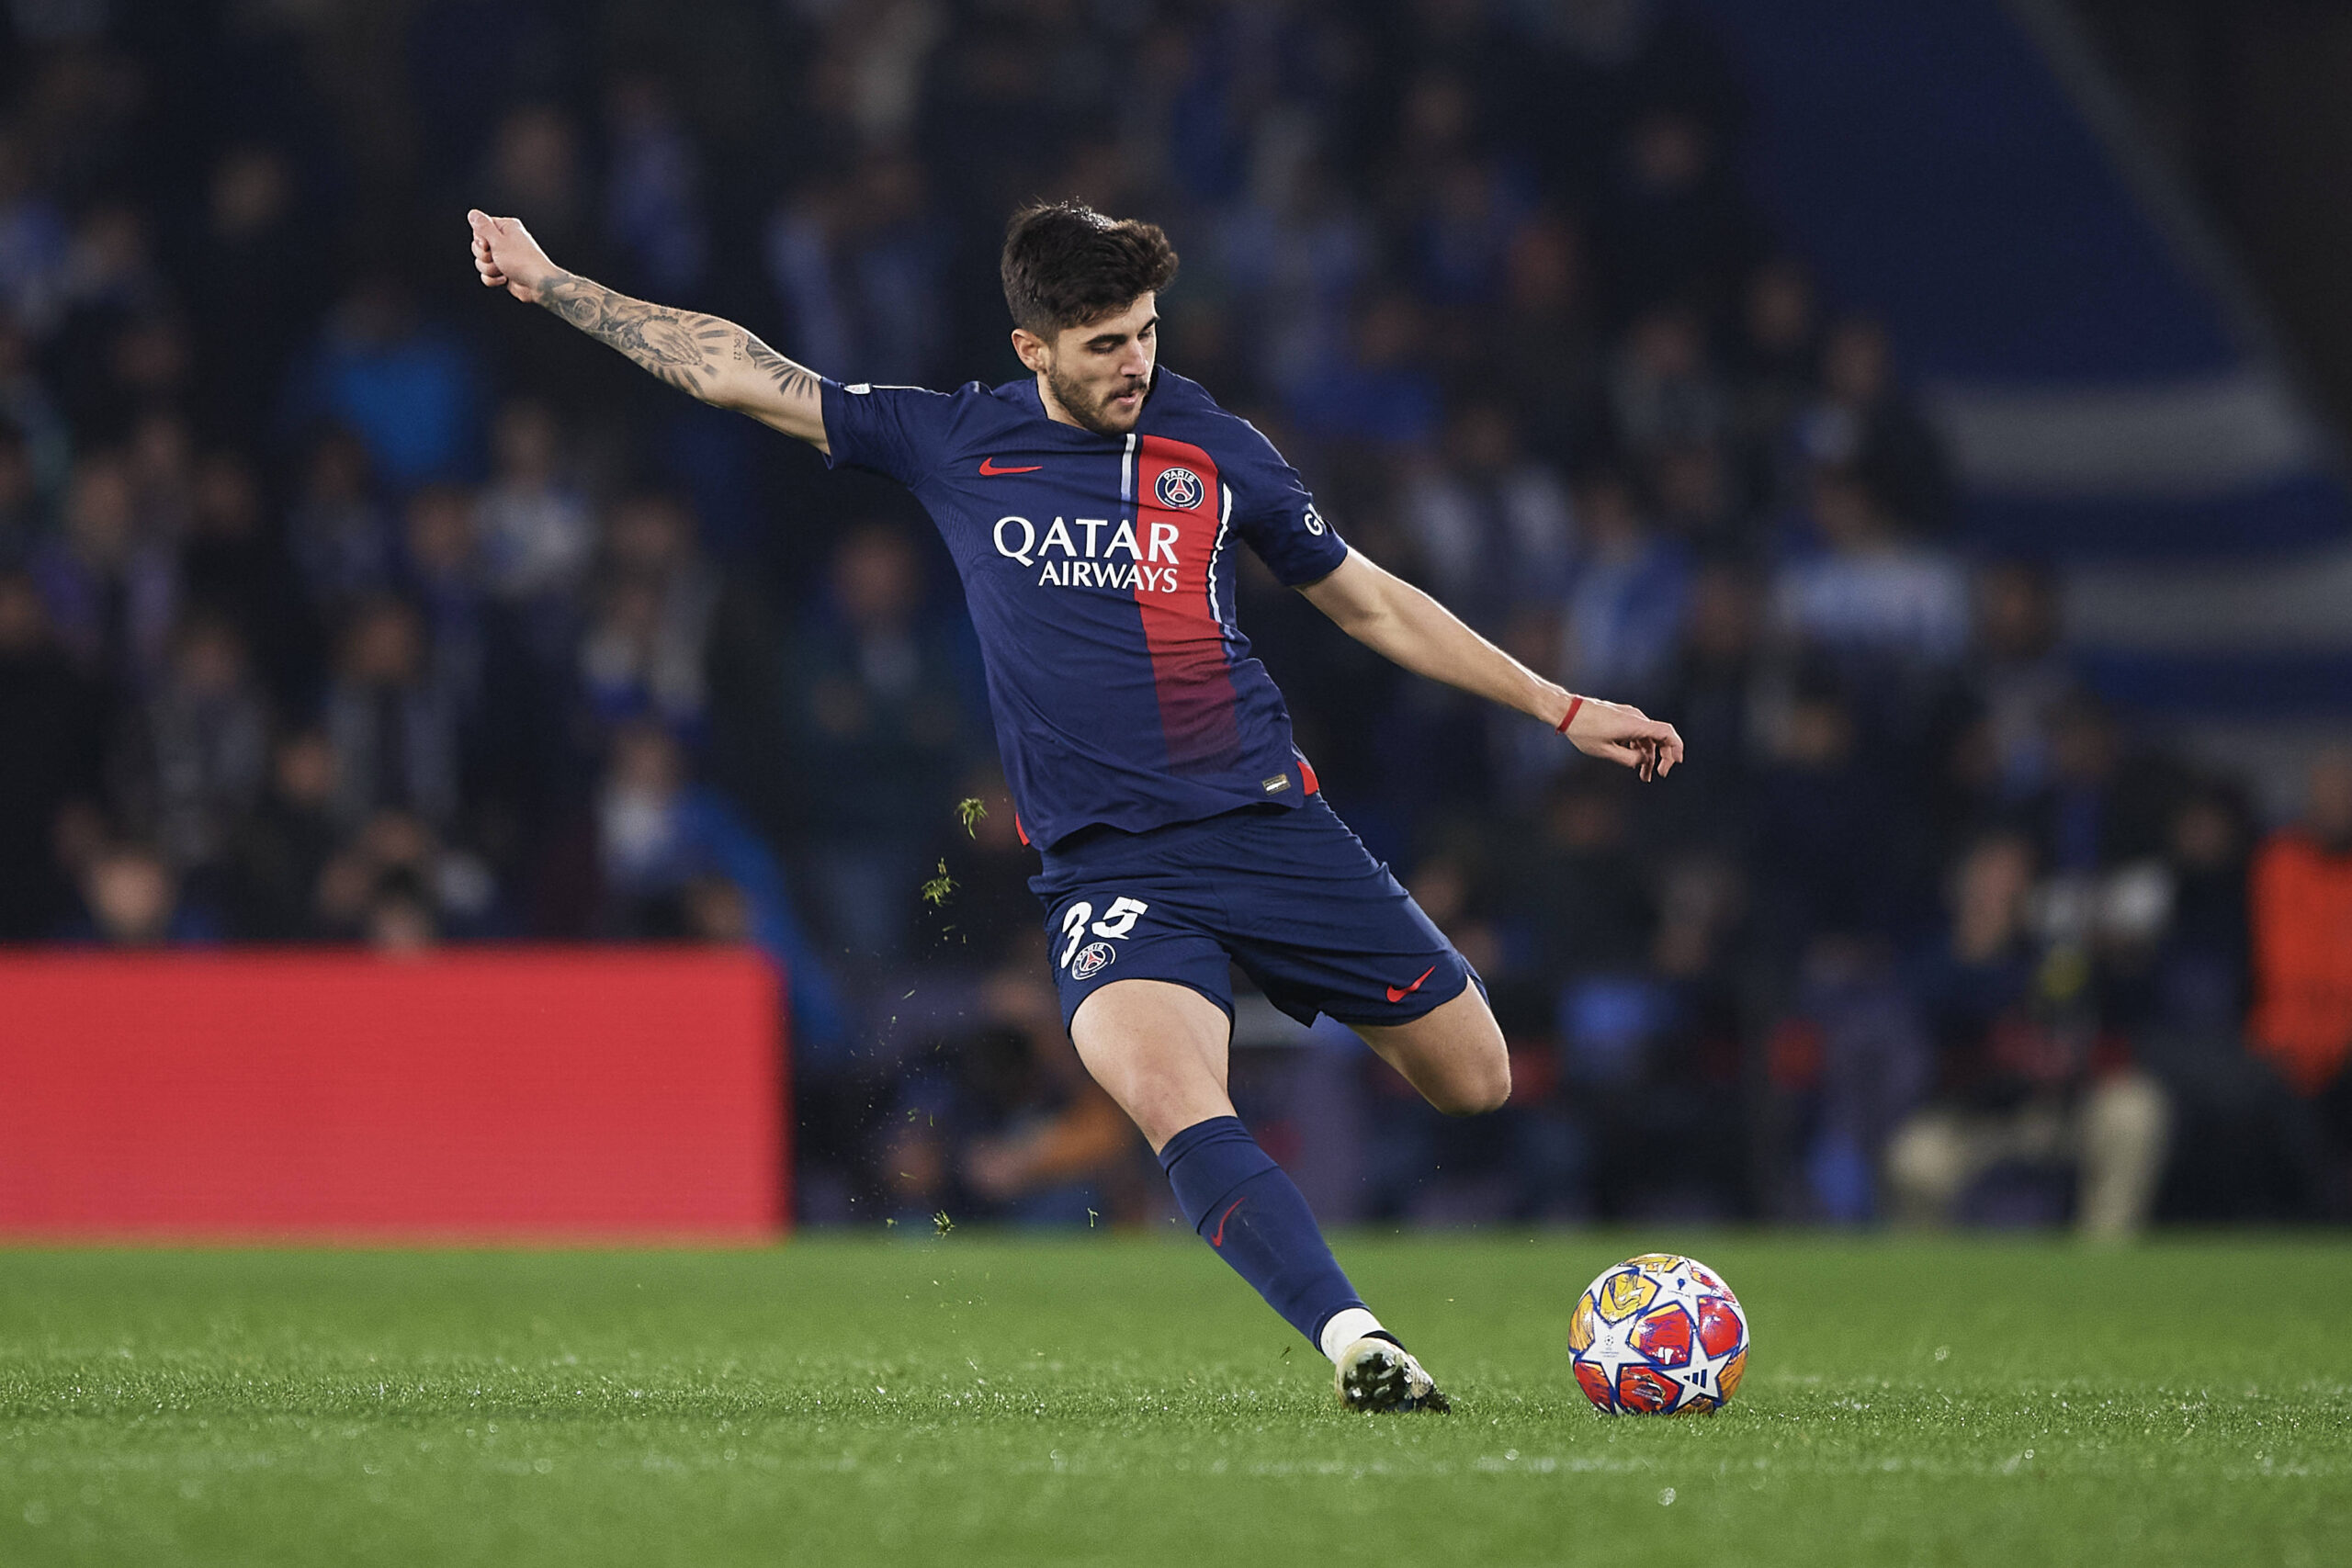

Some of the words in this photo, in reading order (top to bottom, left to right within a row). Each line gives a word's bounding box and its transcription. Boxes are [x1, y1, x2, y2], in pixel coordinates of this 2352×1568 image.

[1163, 470, 1195, 483] PARIS
[993, 516, 1180, 568] QATAR
[1038, 560, 1178, 593] AIRWAYS
[1060, 897, 1148, 969] 35
